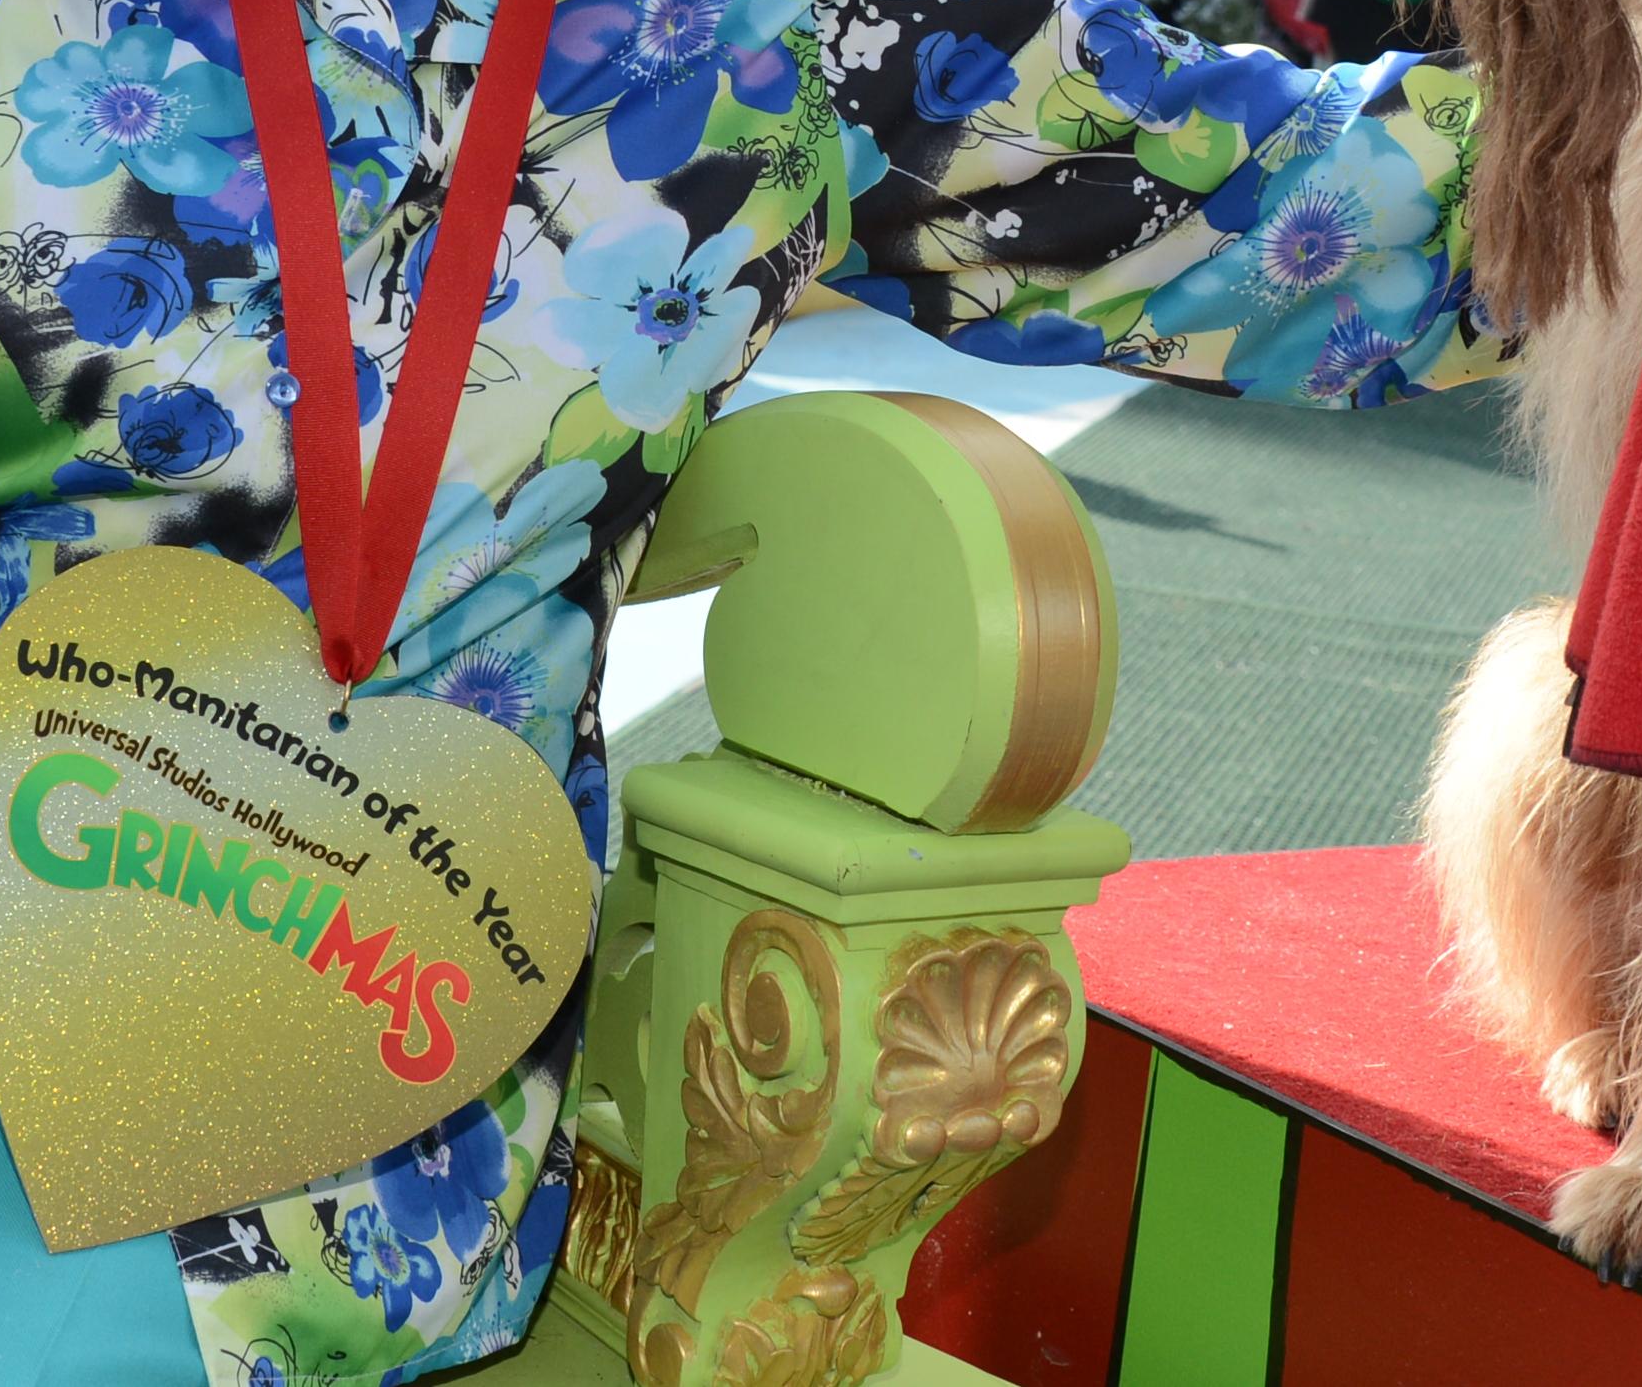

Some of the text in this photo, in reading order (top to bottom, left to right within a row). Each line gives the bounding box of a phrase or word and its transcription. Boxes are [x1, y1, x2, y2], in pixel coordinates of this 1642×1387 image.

[7, 750, 473, 1085] GRINCHMAS
[17, 638, 546, 986] Who-Manitarian of the Year
[34, 708, 371, 877] Universal Studios Hollywood
